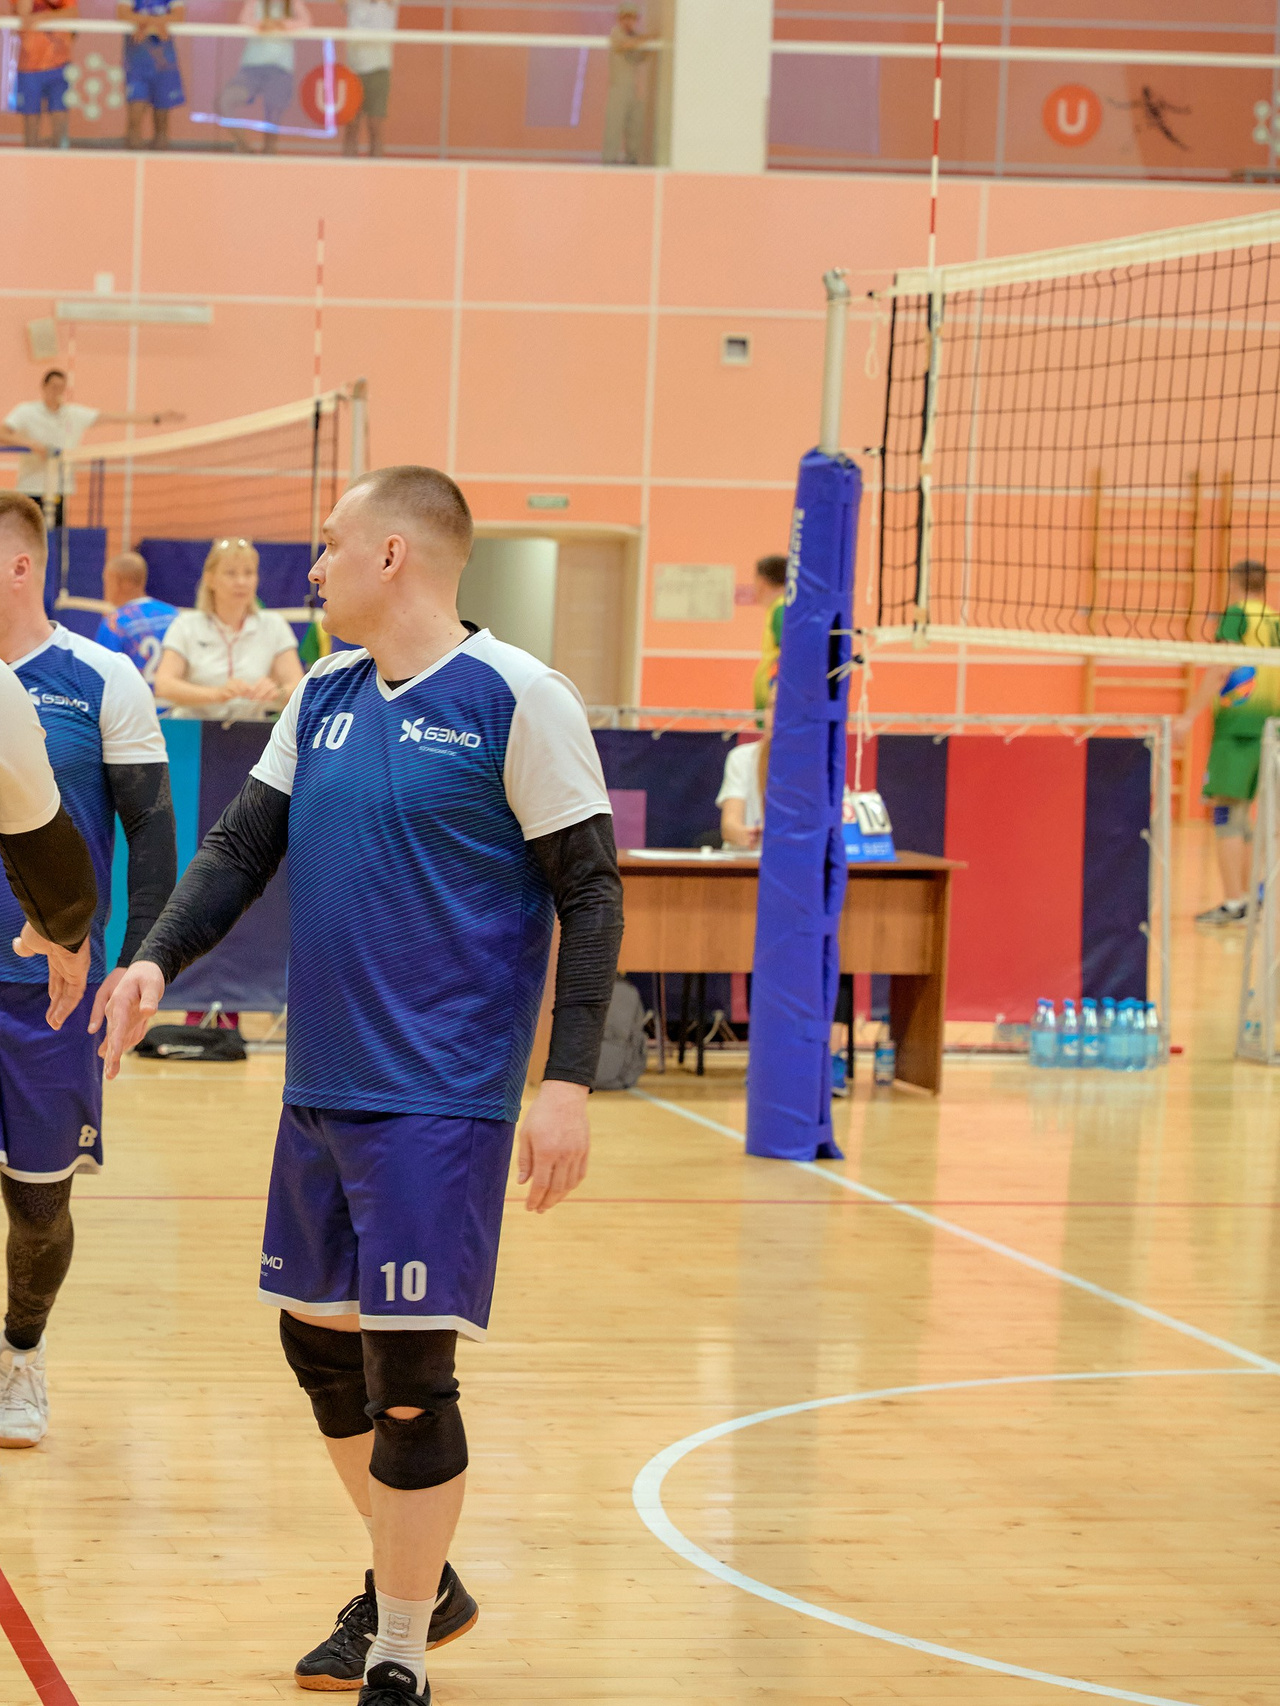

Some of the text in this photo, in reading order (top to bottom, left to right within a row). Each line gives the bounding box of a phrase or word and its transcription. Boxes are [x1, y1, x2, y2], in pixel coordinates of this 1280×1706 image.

[312, 712, 355, 750] 10
[78, 1123, 99, 1147] 8
[380, 1260, 428, 1301] 10
